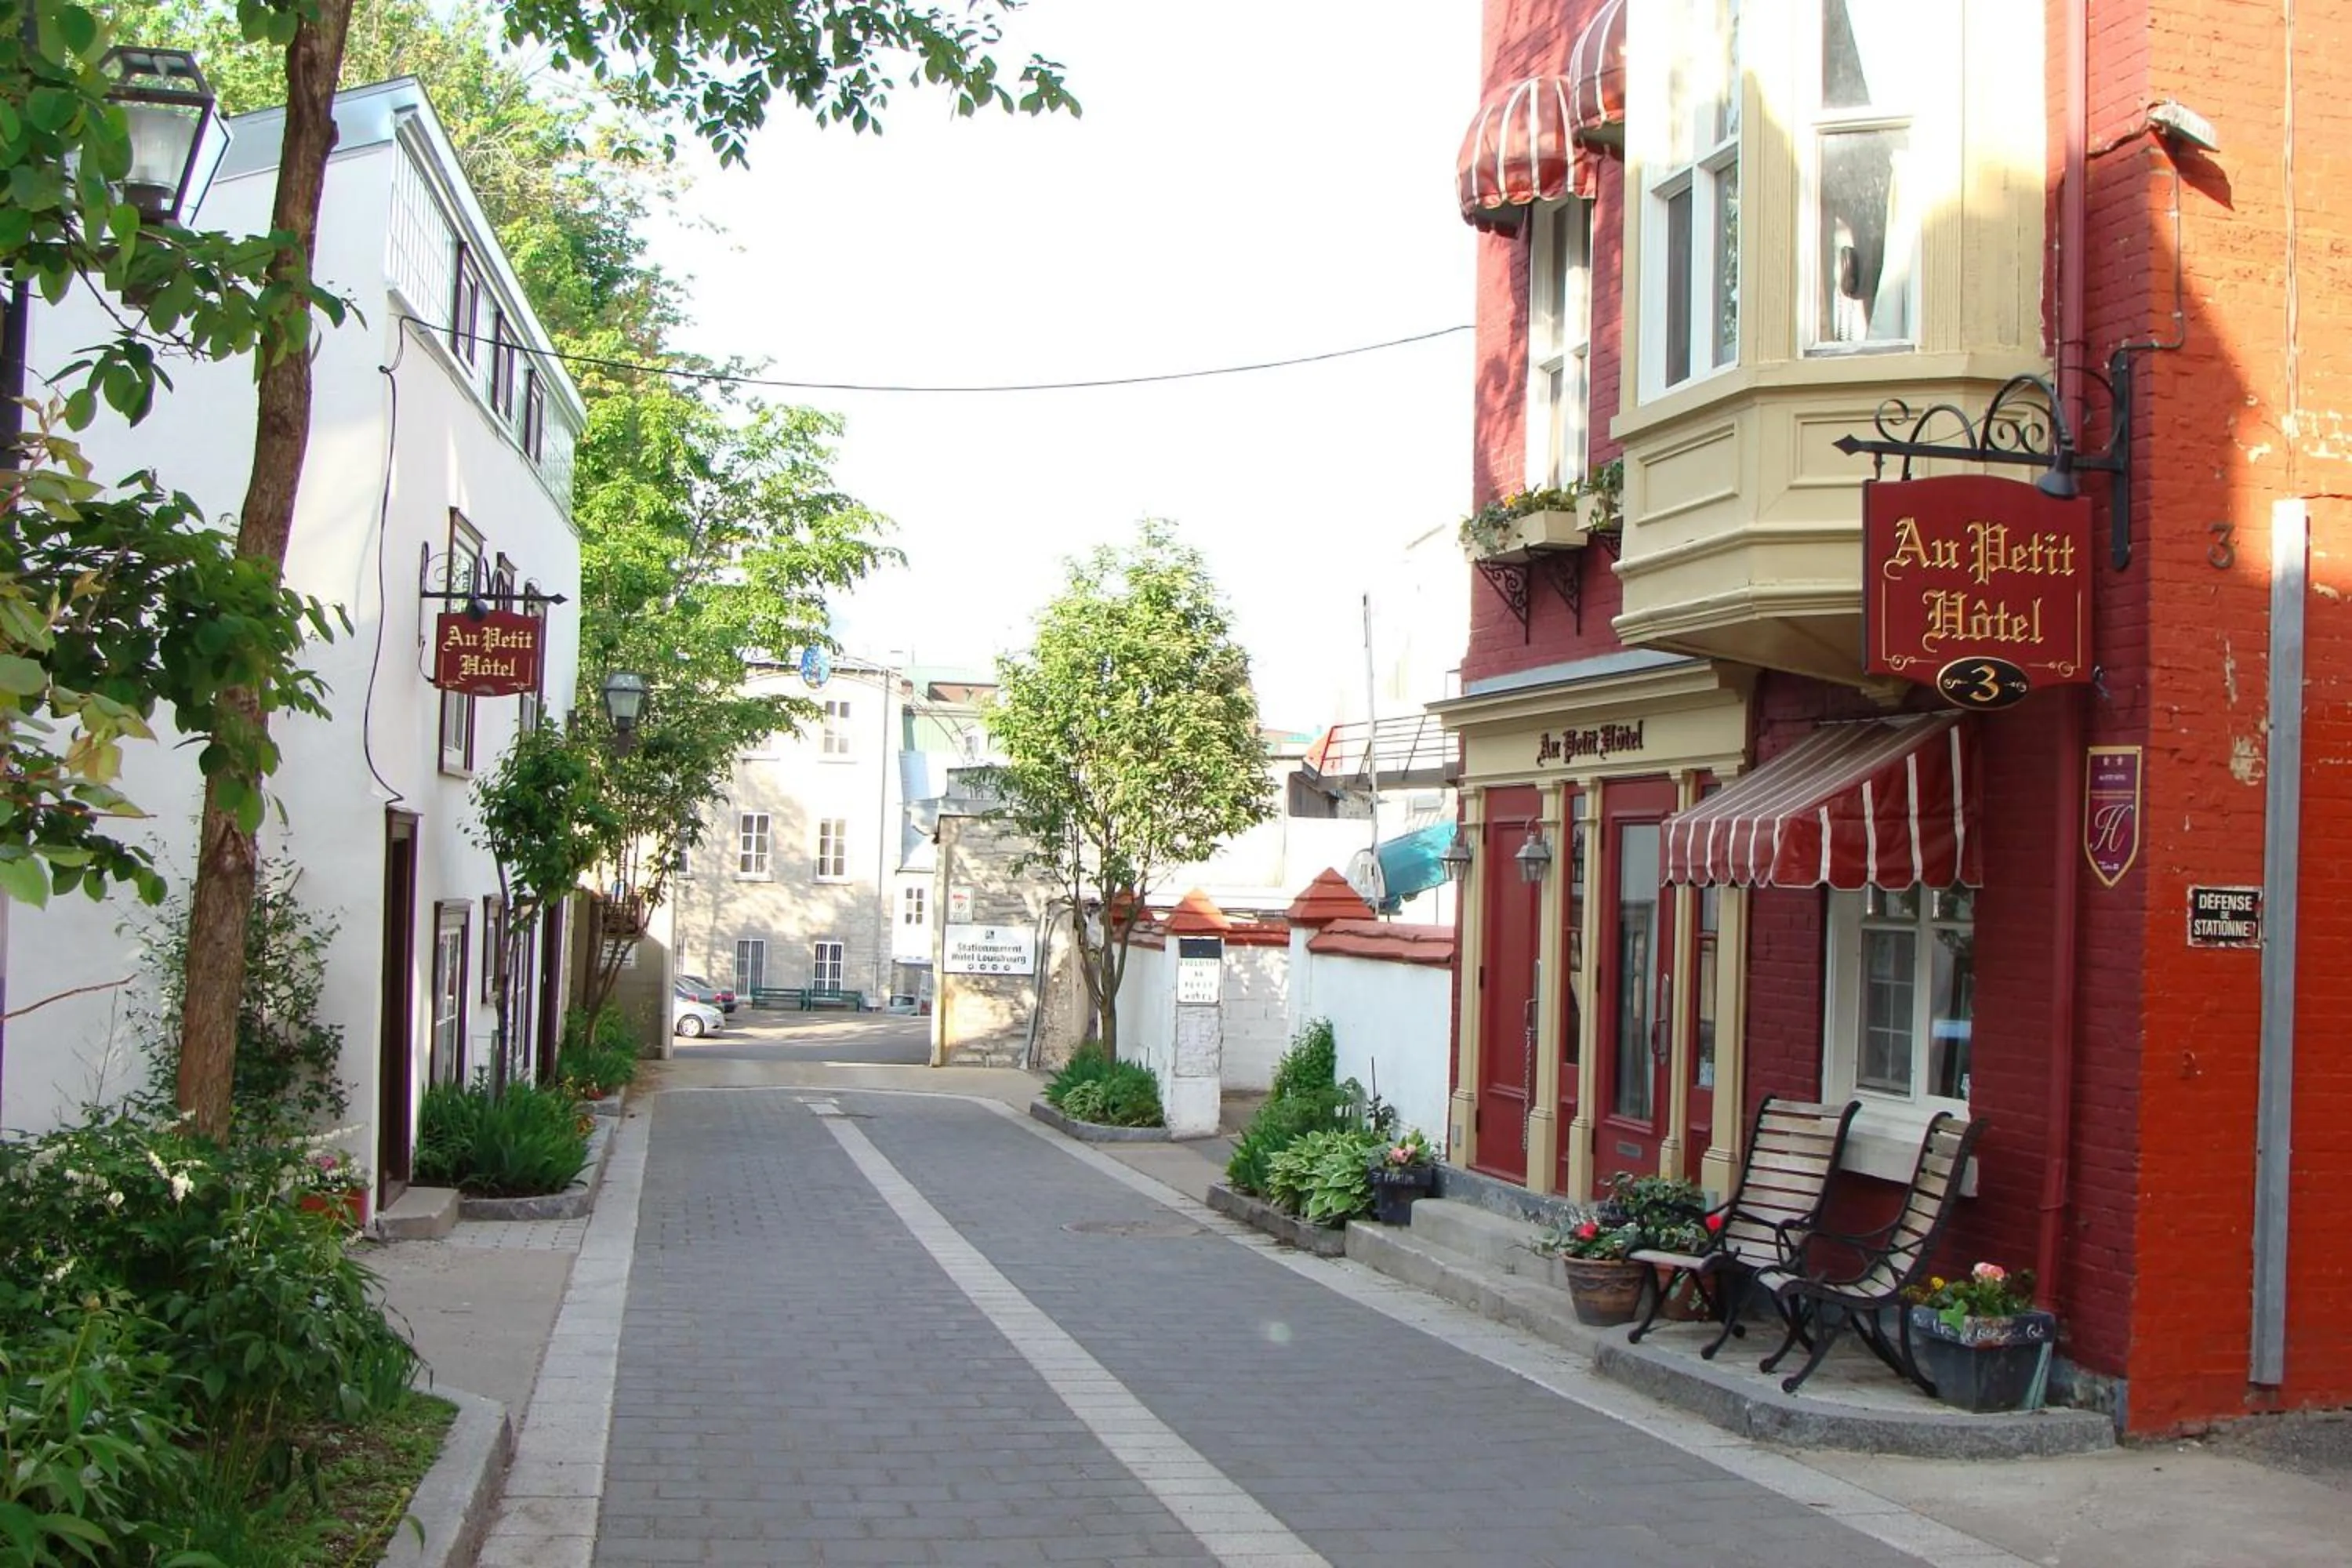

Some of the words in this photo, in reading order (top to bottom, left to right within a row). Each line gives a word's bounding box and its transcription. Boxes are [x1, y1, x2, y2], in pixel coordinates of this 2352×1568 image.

[1883, 517, 1960, 580] Au
[1966, 521, 2075, 586] Petit
[2207, 521, 2236, 570] 3
[441, 625, 478, 652] Au
[481, 626, 533, 653] Petit
[1922, 590, 2044, 653] Hôtel
[459, 654, 516, 681] Hôtel
[1969, 664, 2000, 702] 3
[1537, 732, 1561, 768] Au
[1563, 728, 1599, 764] Petit
[1599, 719, 1644, 760] Hôtel
